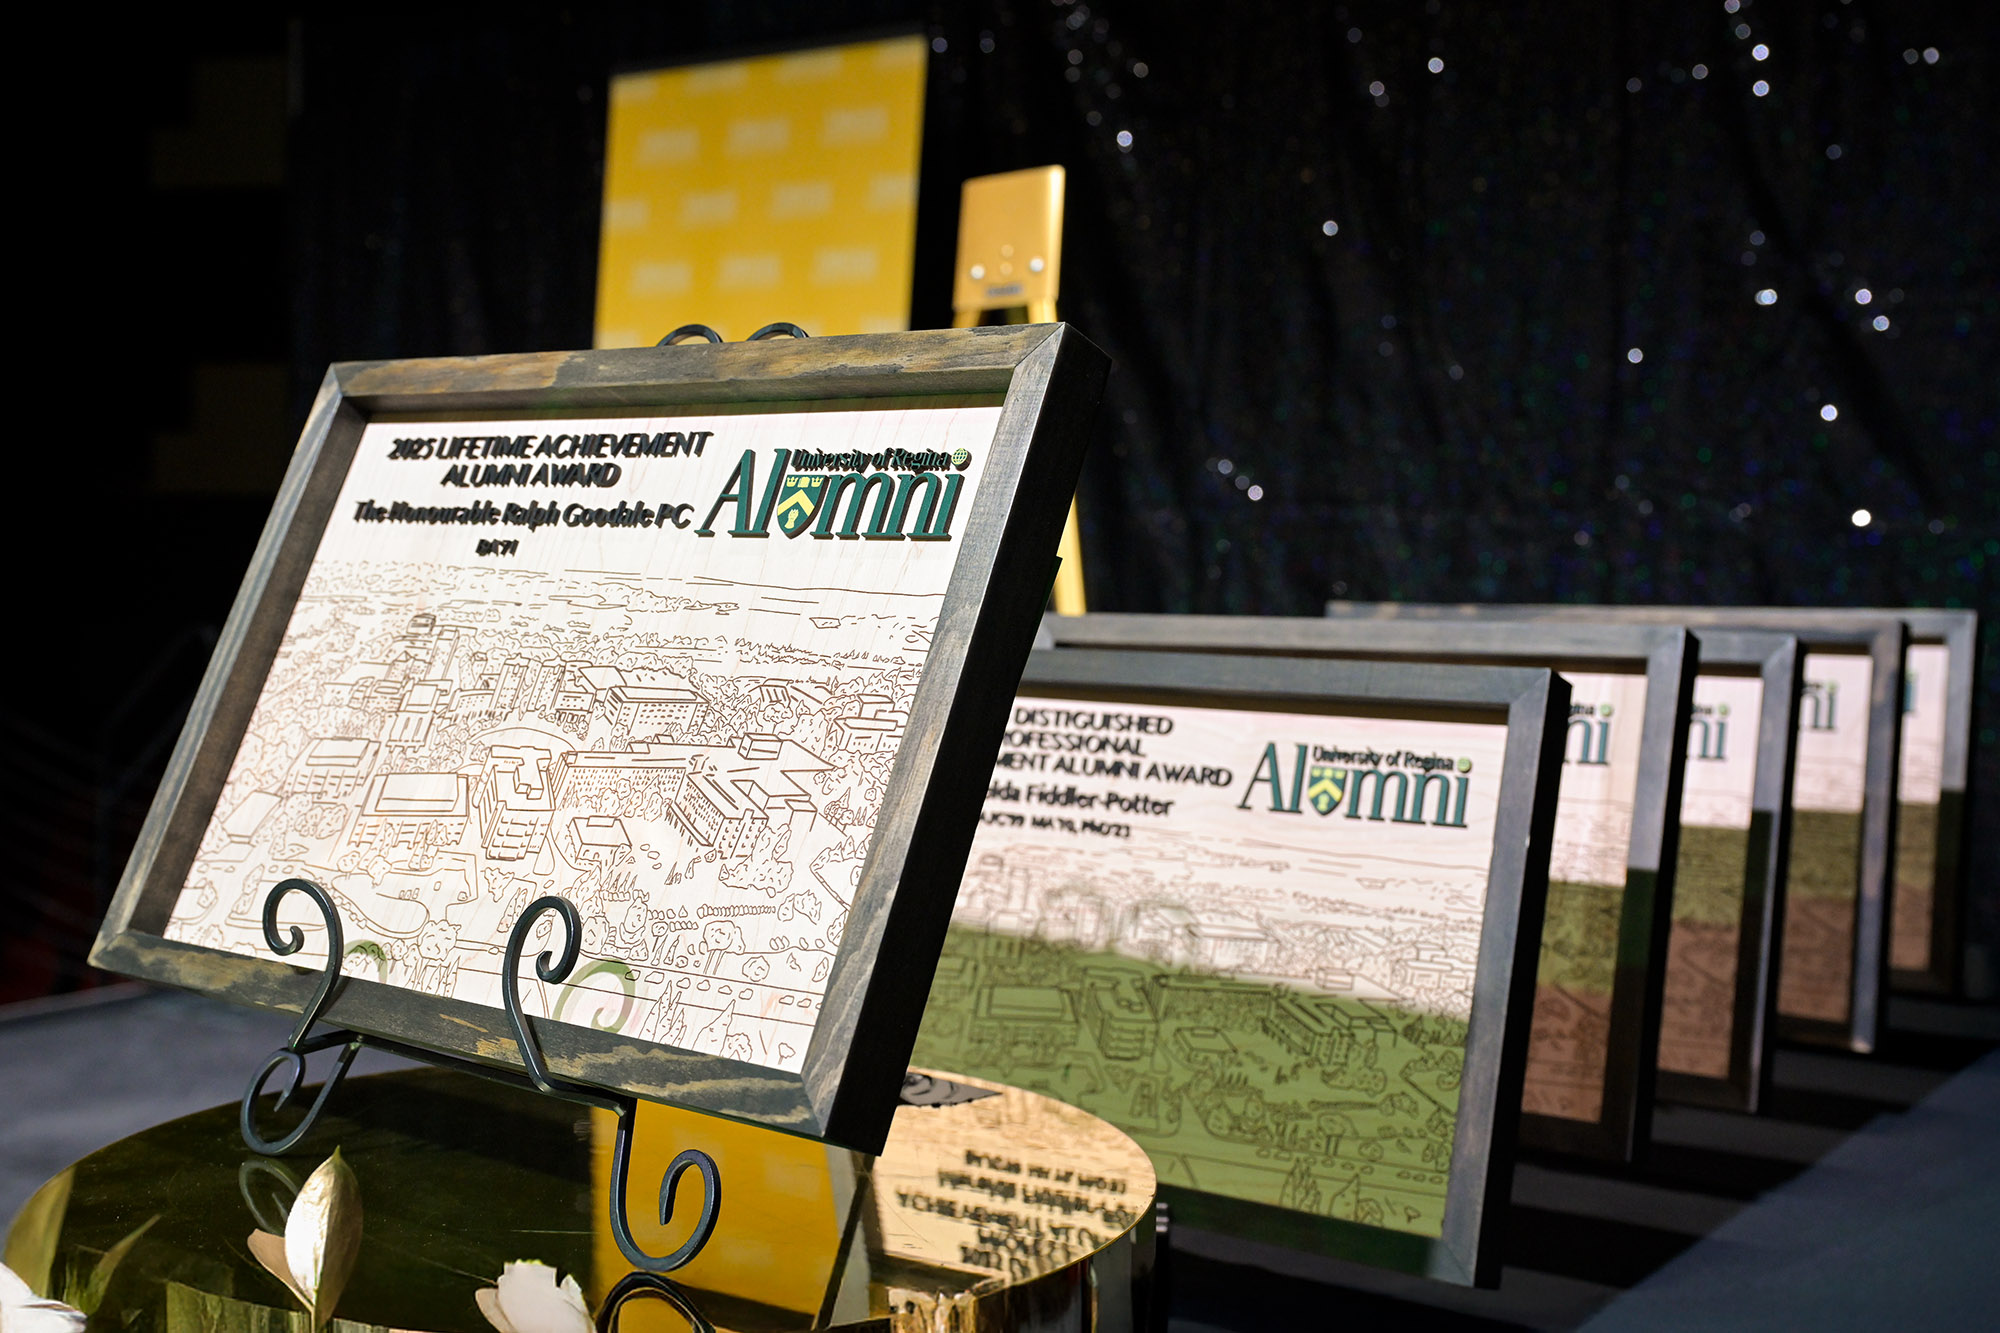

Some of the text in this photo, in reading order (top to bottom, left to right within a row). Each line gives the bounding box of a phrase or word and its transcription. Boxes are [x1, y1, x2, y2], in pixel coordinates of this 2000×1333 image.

[387, 431, 714, 460] 2025 LIFETIME ACHIEVEMENT
[440, 462, 622, 488] ALUMNI AWARD
[791, 447, 951, 475] University of Regina
[353, 499, 694, 532] The Honourable Ralph Goodale PC
[1053, 755, 1141, 780] ALUMNI
[1146, 763, 1233, 787] AWARD
[1313, 745, 1453, 772] University of Regina
[1027, 784, 1175, 816] Fiddler-Potter
